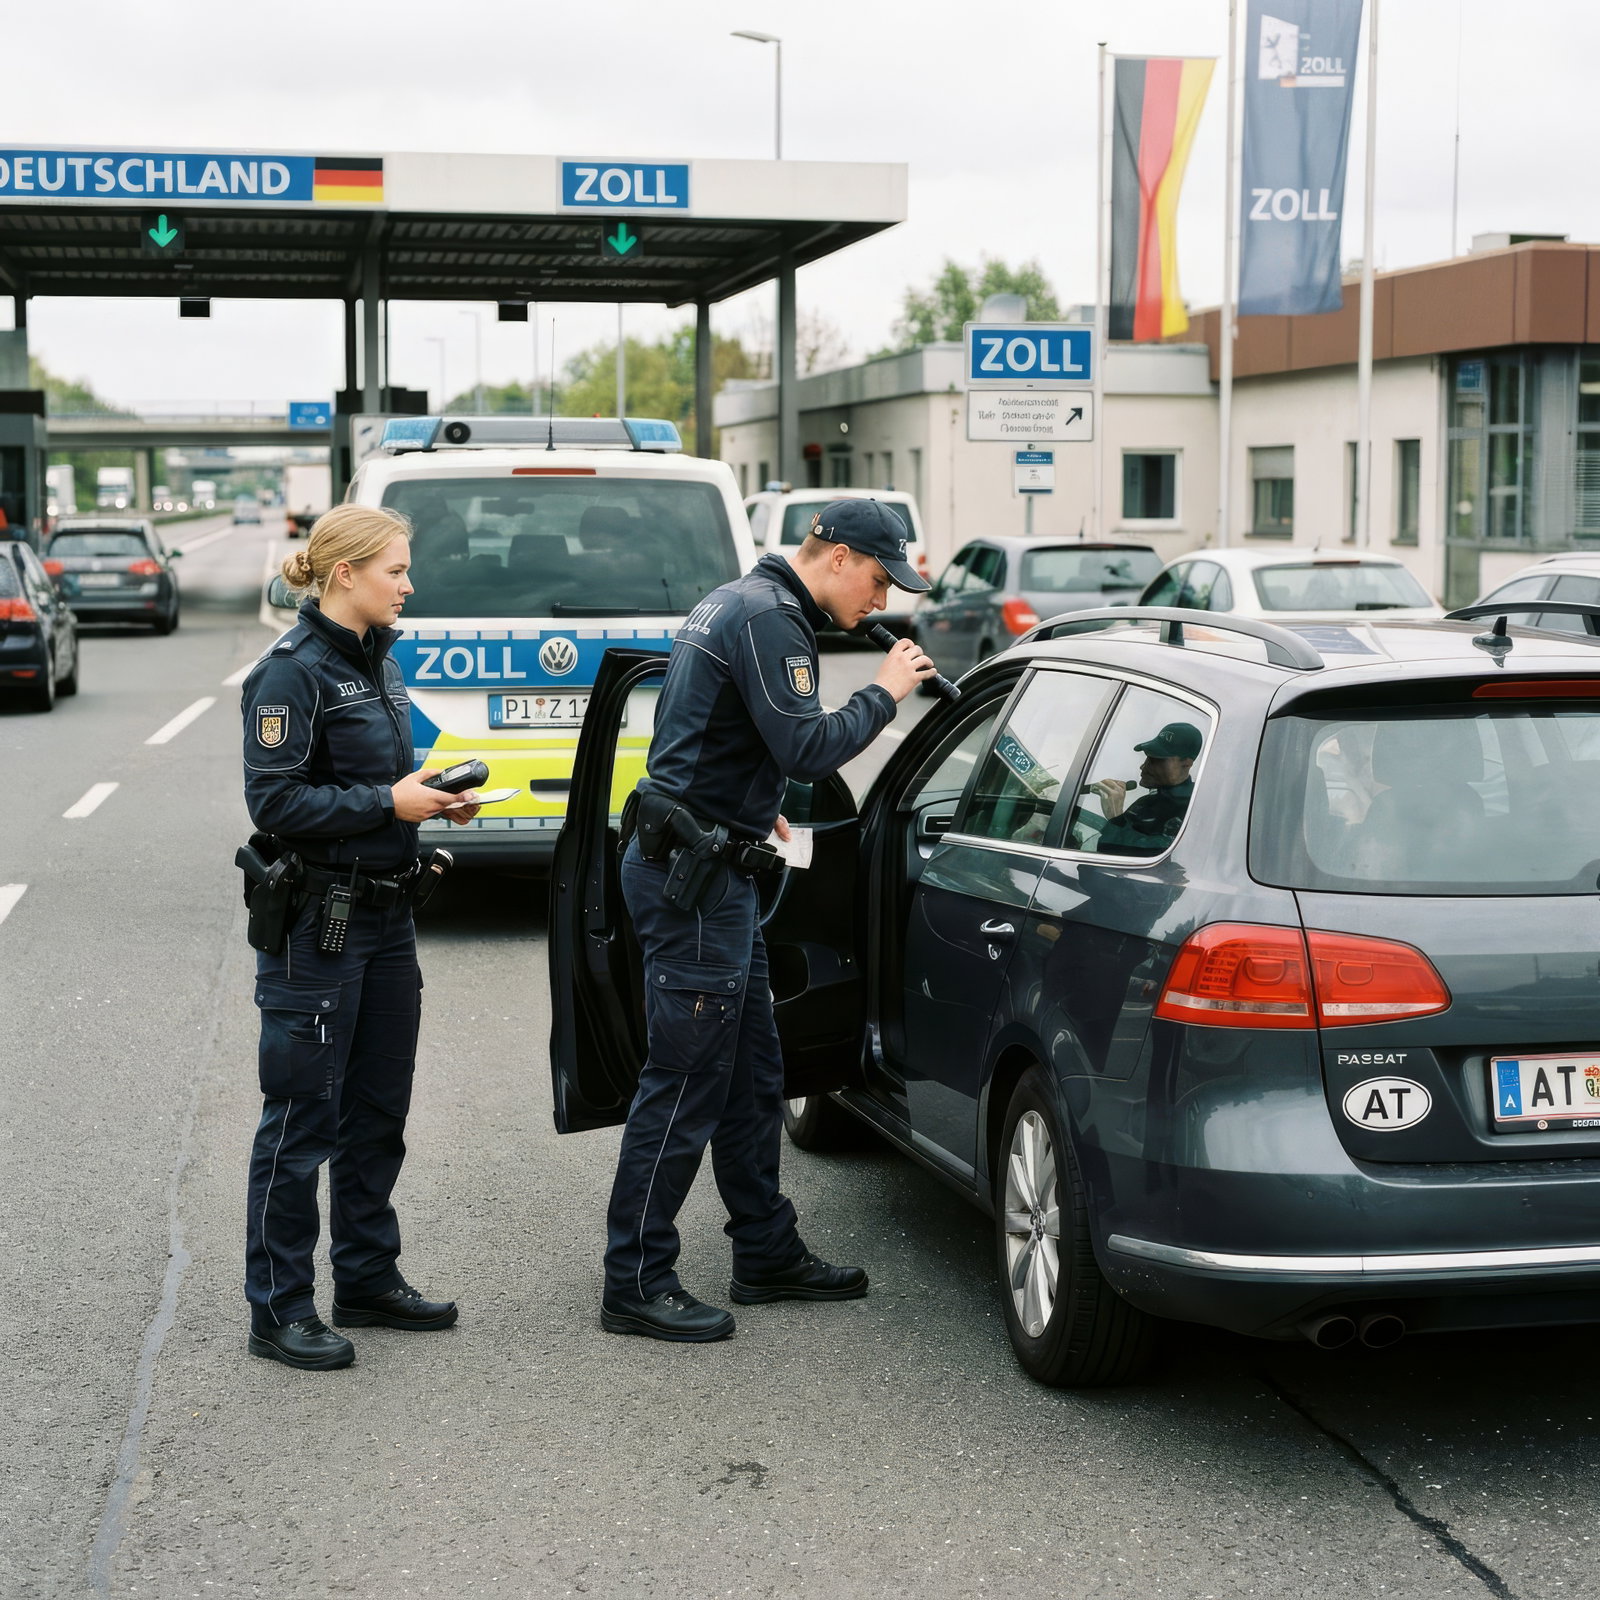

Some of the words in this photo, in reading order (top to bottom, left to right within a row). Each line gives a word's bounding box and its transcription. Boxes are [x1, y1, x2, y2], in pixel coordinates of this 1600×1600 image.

[1301, 56, 1346, 73] ZOLL
[574, 168, 678, 204] ZOLL
[1249, 187, 1338, 221] ZOLL
[980, 337, 1083, 372] ZOLL
[415, 646, 527, 680] ZOLL
[1362, 1087, 1411, 1120] AT
[1505, 1094, 1517, 1108] A
[1531, 1066, 1577, 1108] AT
